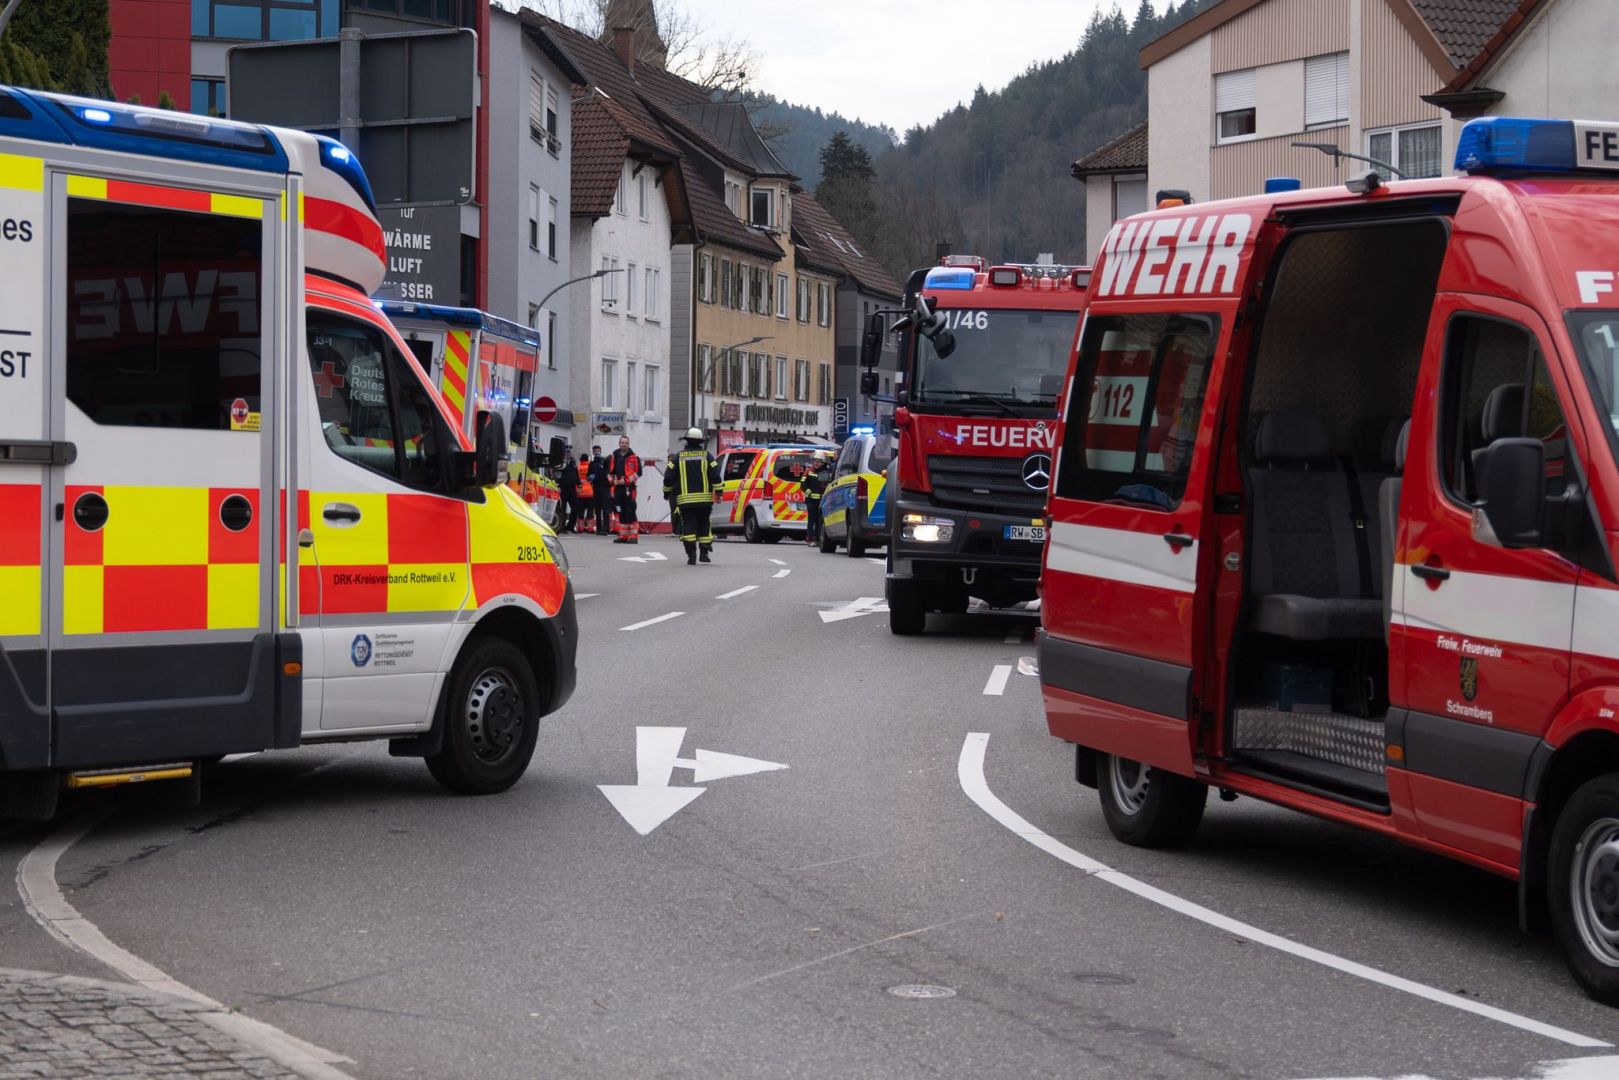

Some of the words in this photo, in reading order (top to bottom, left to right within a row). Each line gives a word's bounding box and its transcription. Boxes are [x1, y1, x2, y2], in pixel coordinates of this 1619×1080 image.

[0, 218, 33, 243] es
[383, 228, 432, 250] WÄRME
[1098, 213, 1251, 296] WEHR
[390, 257, 423, 274] LUFT
[384, 281, 433, 299] SSER
[1575, 271, 1619, 304] F
[0, 350, 32, 378] ST
[350, 377, 385, 392] Rotes
[349, 389, 385, 403] Kreuz
[1103, 383, 1134, 418] 112
[784, 493, 806, 502] NO
[1011, 527, 1024, 539] RW
[1030, 527, 1043, 539] SB
[517, 546, 546, 561] 2/83-1
[333, 573, 408, 585] DRK-Kreisverband
[410, 572, 441, 584] Rottweil
[443, 572, 457, 583] e.V.
[1437, 635, 1460, 651] Freiw.
[1462, 639, 1503, 658] Feuerwehr
[1447, 699, 1493, 724] Schramberg
